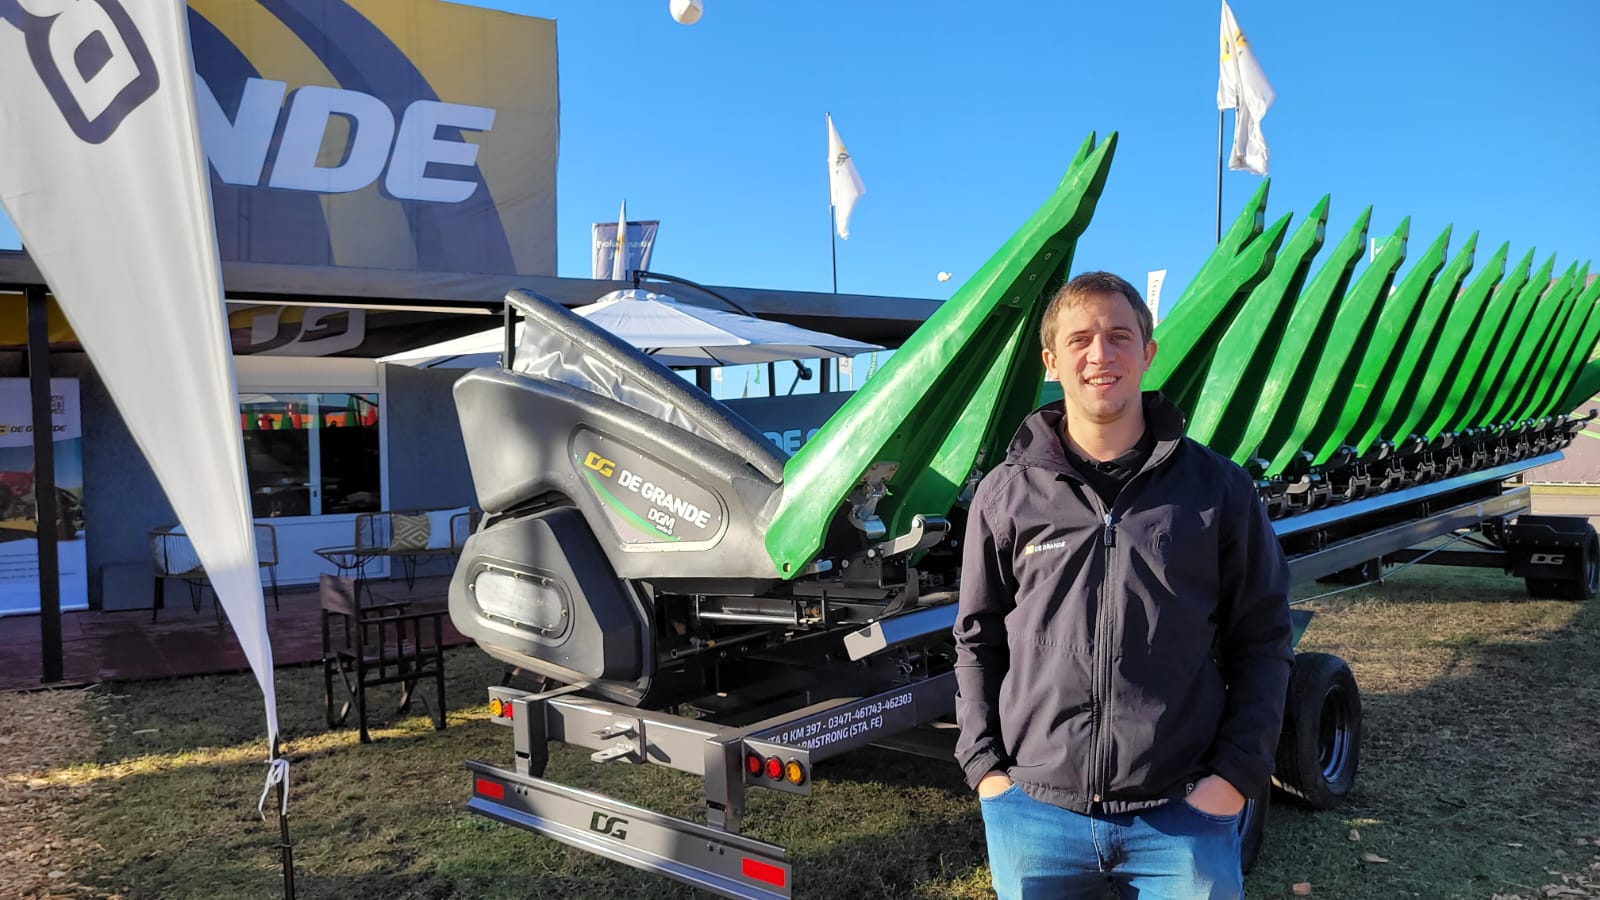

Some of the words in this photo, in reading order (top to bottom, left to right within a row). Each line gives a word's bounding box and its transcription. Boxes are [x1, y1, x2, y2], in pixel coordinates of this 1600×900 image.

[584, 451, 616, 478] DG
[617, 470, 643, 492] DE
[641, 482, 711, 529] GRANDE
[647, 507, 676, 529] DGM
[782, 732, 789, 744] 9
[790, 727, 805, 742] KM
[806, 721, 822, 737] 397
[797, 727, 849, 749] RMSTRONG
[870, 716, 883, 731] FE)
